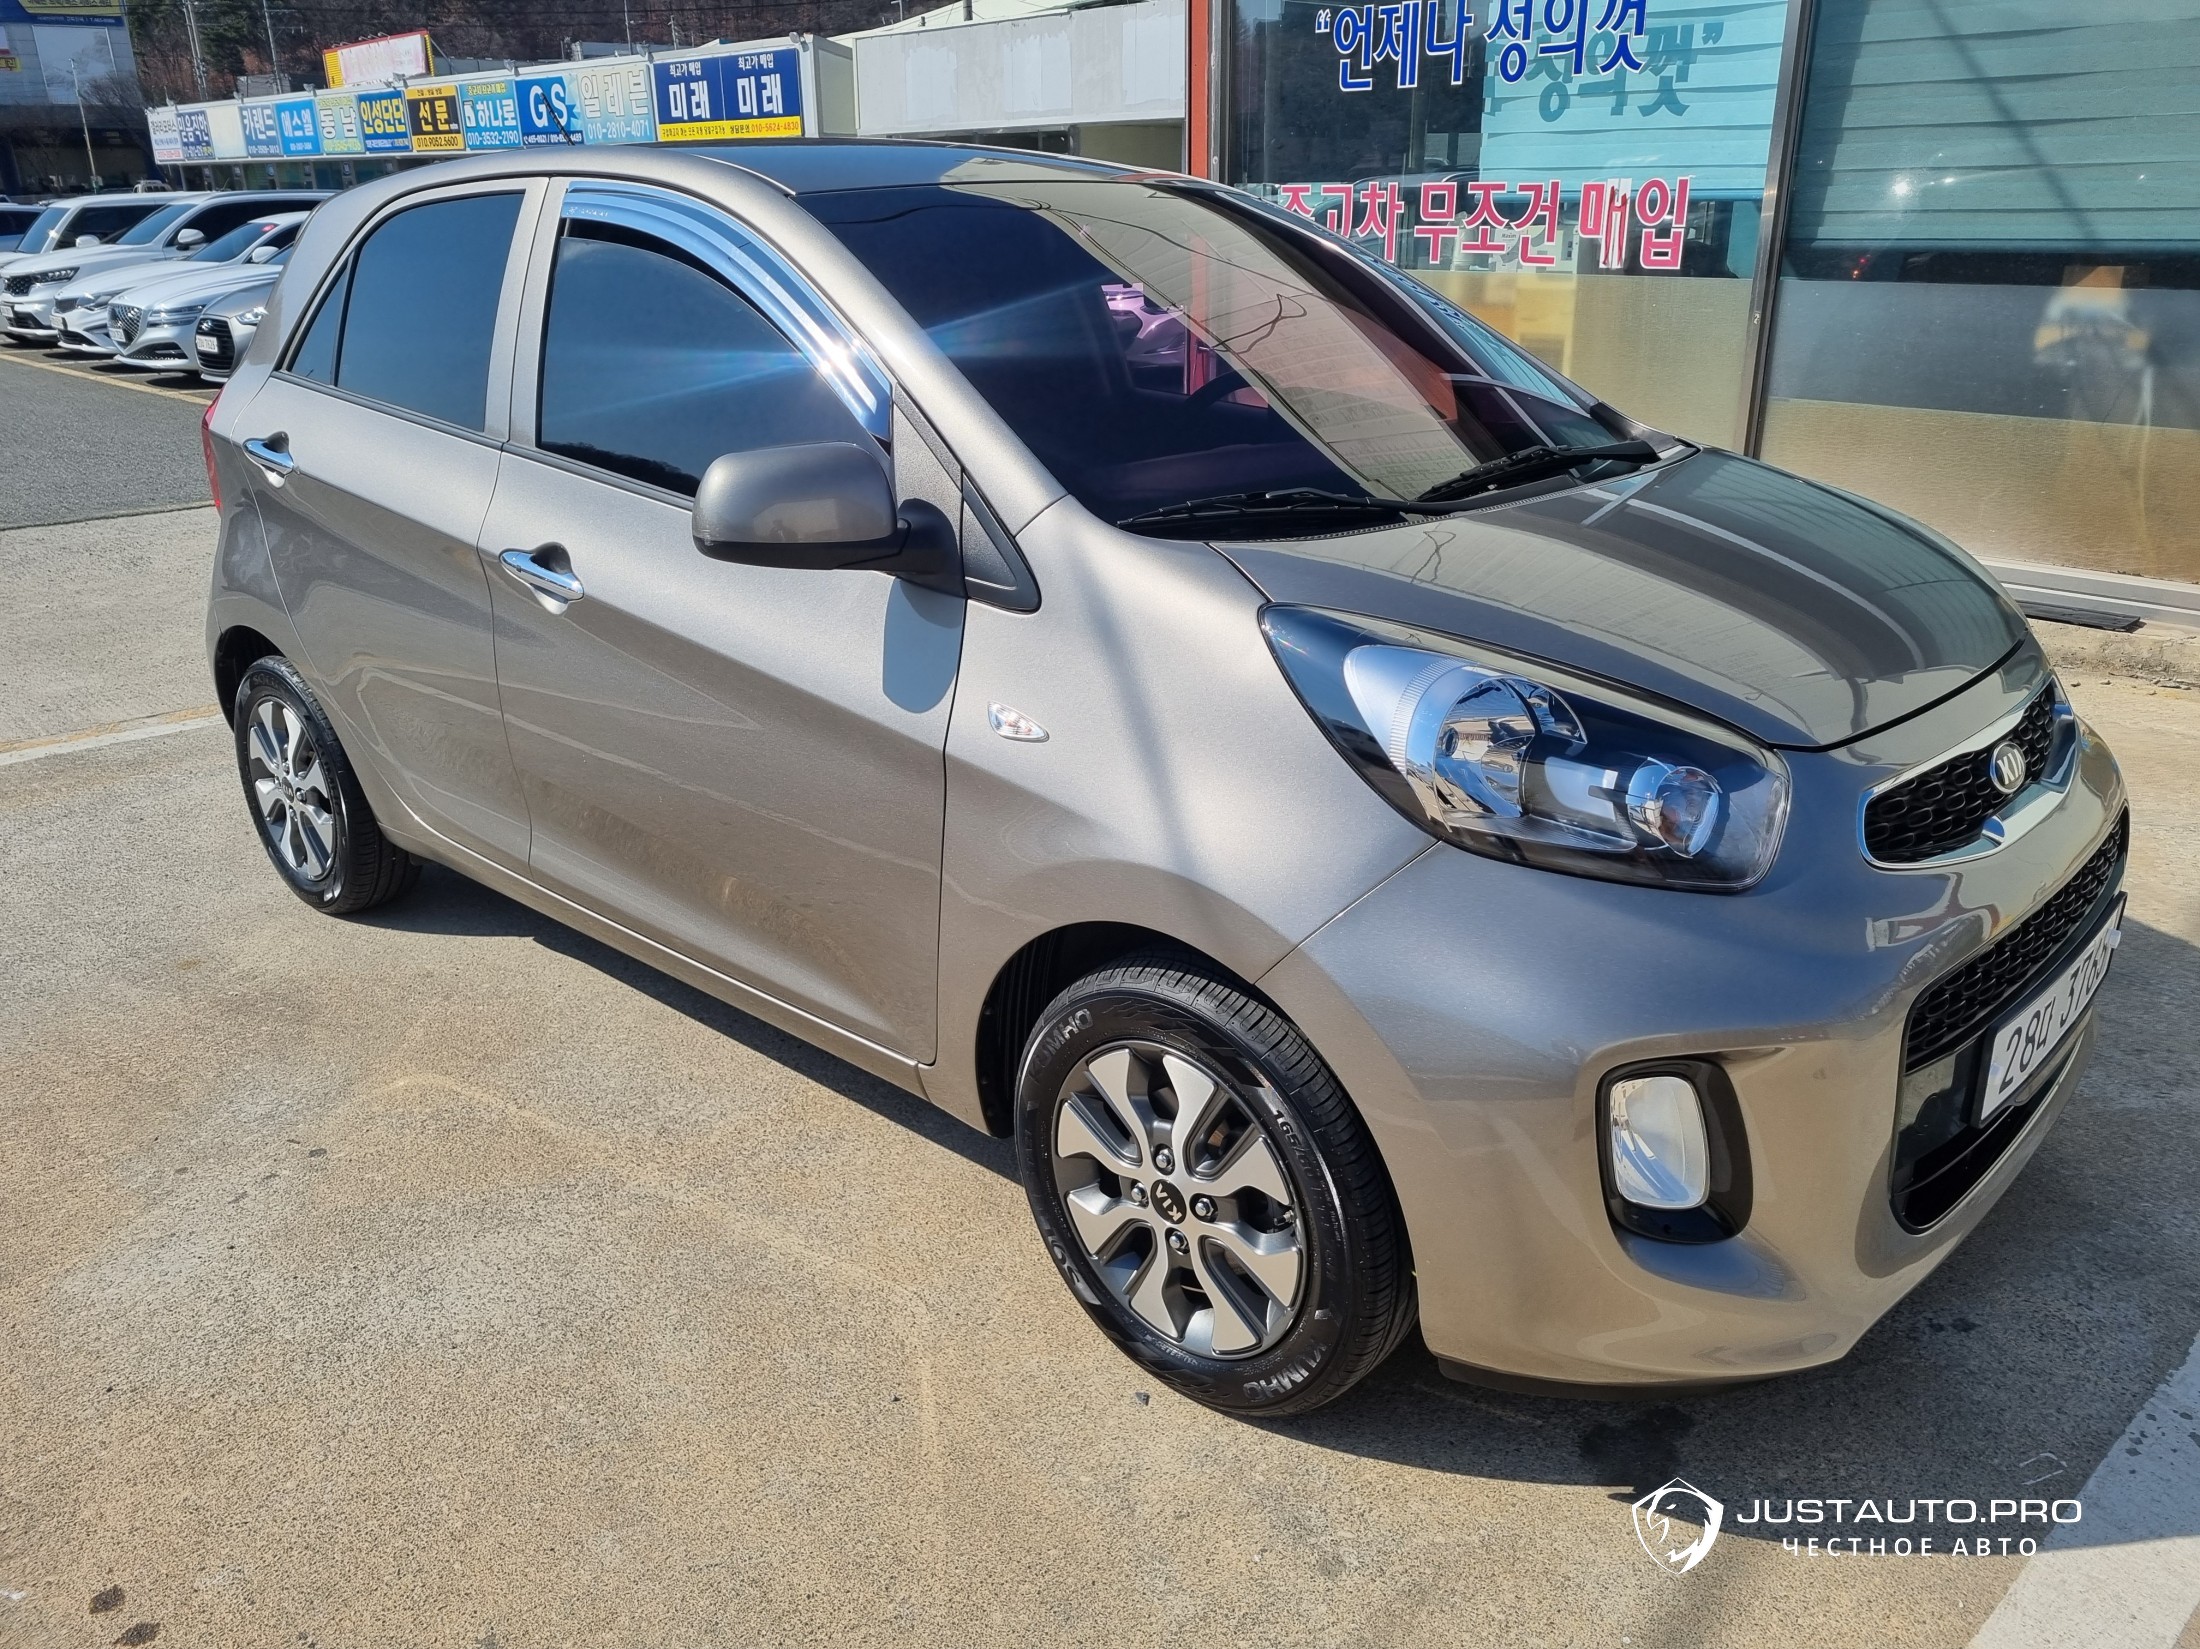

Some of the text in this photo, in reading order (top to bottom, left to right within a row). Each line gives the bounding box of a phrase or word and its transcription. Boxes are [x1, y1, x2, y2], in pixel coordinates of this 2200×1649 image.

[1483, 0, 1648, 84] 성의껏
[669, 61, 702, 78] 최고가 매입
[737, 53, 774, 71] 최고가 매입
[476, 99, 517, 128] 하나로
[529, 83, 568, 128] GS
[580, 70, 649, 119] 일레븐
[668, 80, 711, 120] 미래
[736, 73, 783, 117] 미래
[177, 112, 209, 143] 믿음직한
[319, 106, 358, 139] 동남
[361, 98, 406, 134] 인성단단
[419, 100, 450, 131] 선문
[587, 119, 650, 140] 010-2810-4071
[416, 136, 459, 148] 010.9052.5600
[467, 130, 519, 146] 010-3532-2190
[1413, 179, 1561, 267] 무조건
[1578, 176, 1691, 270] 매입
[1997, 748, 2026, 786] KIA
[1028, 1008, 1094, 1078] KUMHO
[1999, 996, 2057, 1095] 28다
[1155, 1182, 1183, 1222] KIA
[1242, 1340, 1328, 1402] KUMHO
